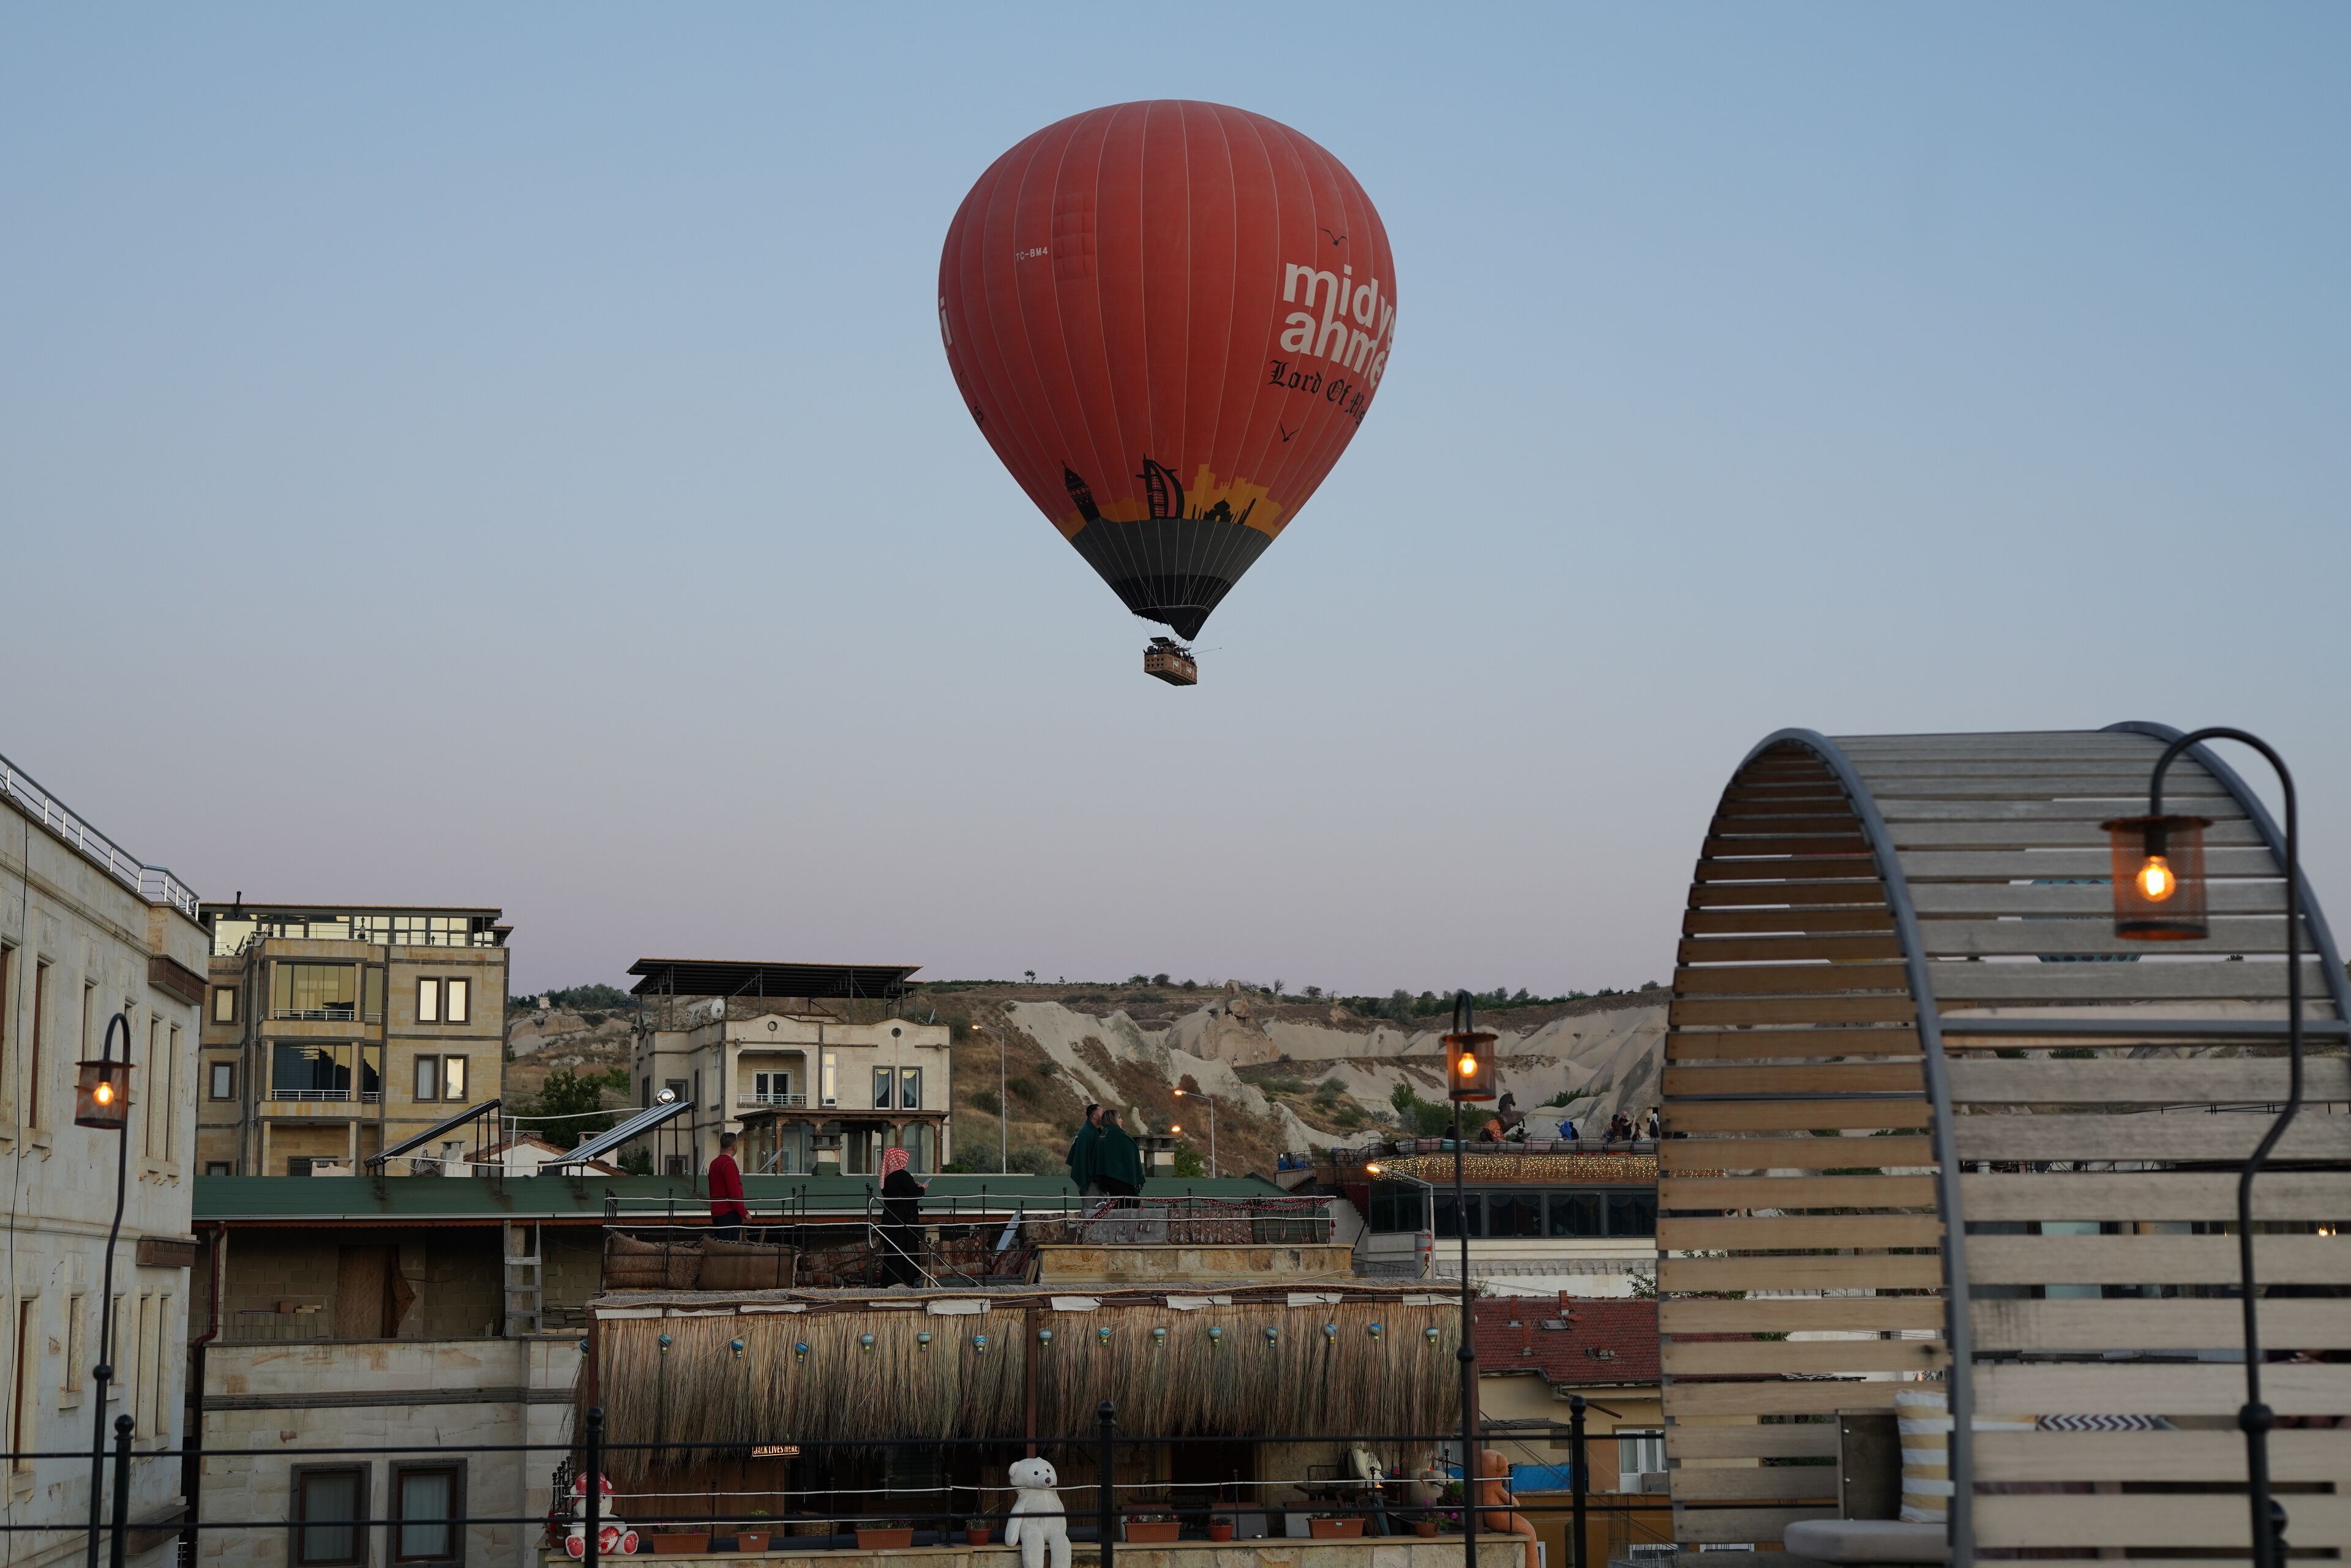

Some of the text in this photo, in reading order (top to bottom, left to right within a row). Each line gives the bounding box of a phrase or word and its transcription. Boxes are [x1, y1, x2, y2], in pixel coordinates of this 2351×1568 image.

[1016, 247, 1048, 261] TC-BM4
[1279, 307, 1387, 390] ahme
[1267, 359, 1322, 394] Lord
[1327, 378, 1352, 406] Of
[754, 1446, 768, 1455] JACK
